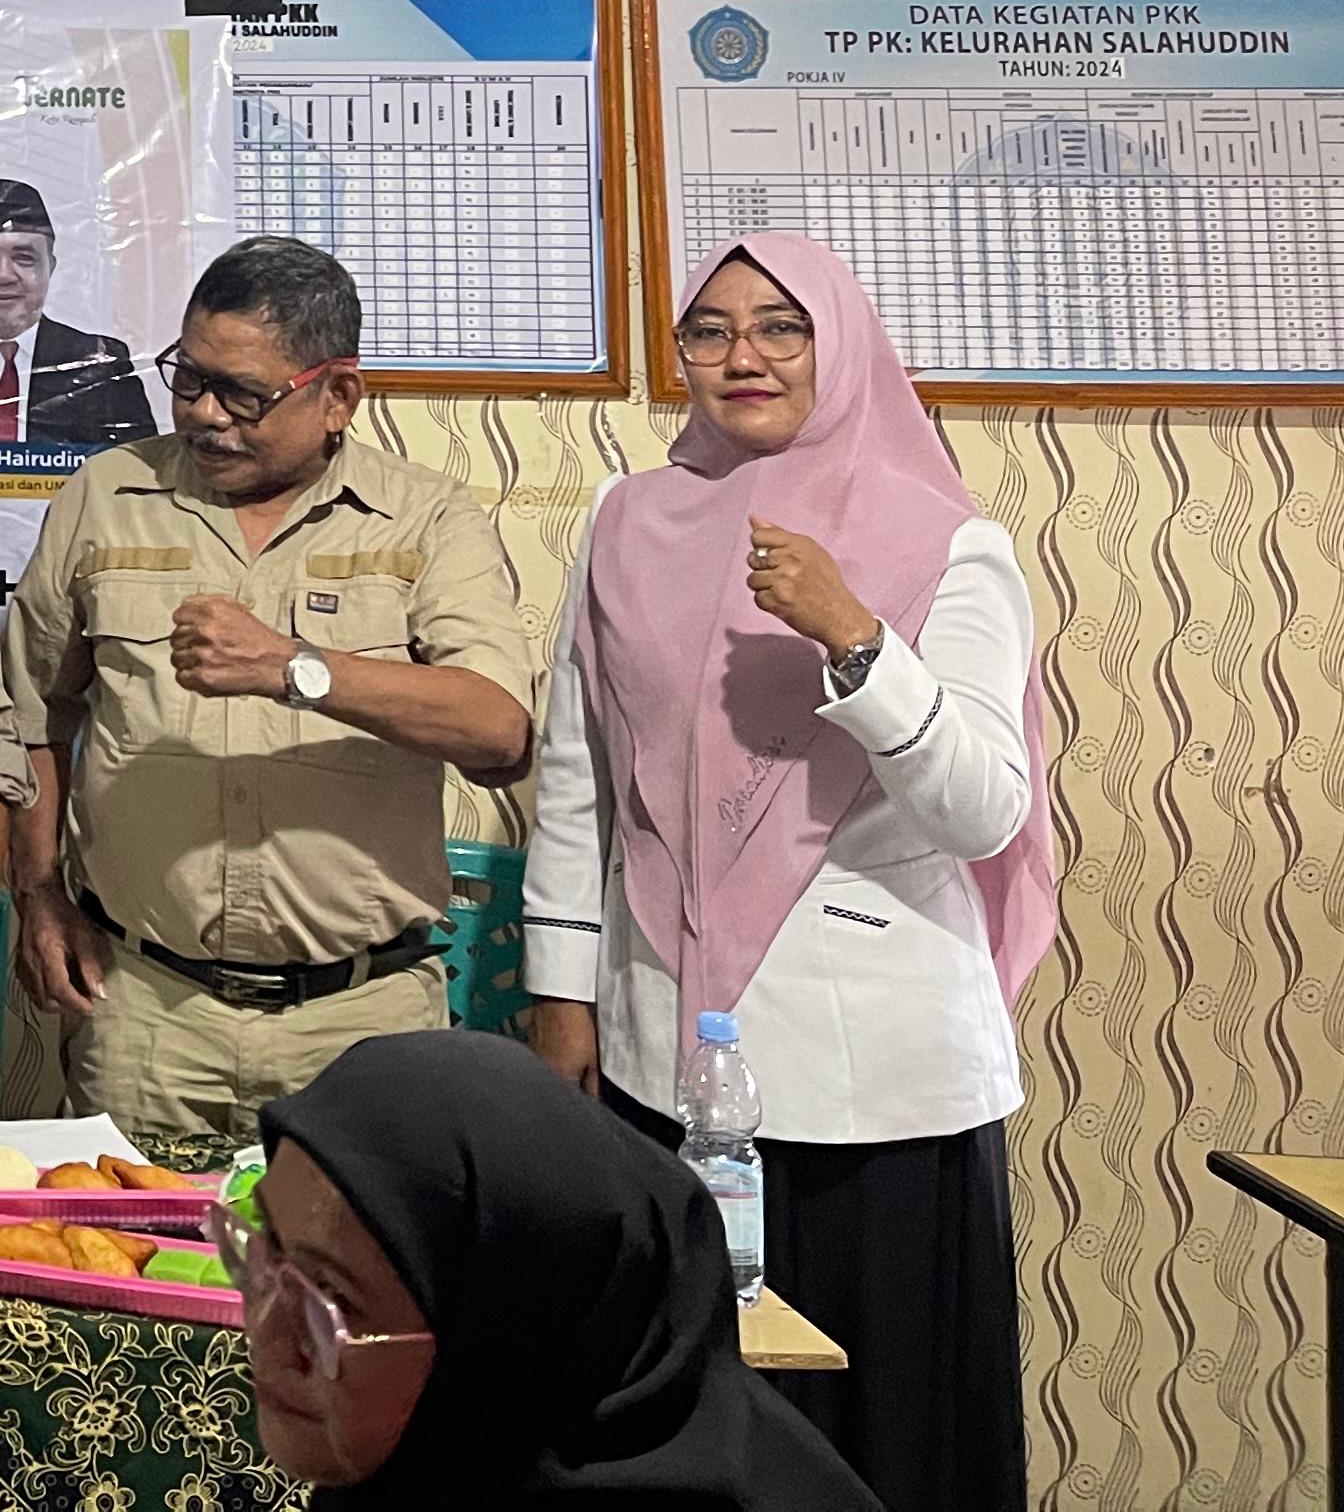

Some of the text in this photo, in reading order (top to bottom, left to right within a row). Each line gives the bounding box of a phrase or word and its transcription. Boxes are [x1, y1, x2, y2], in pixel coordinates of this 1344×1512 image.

[909, 4, 1201, 25] DATA KEGIATAN PKK
[241, 25, 338, 37] SALAHUDDIN
[232, 39, 267, 52] 2024
[824, 32, 1290, 55] TP PK: KELURAHAN SALAHUDDIN
[998, 59, 1122, 78] TAHUN: 2024
[787, 71, 846, 84] POKJA IV
[17, 479, 42, 491] dan
